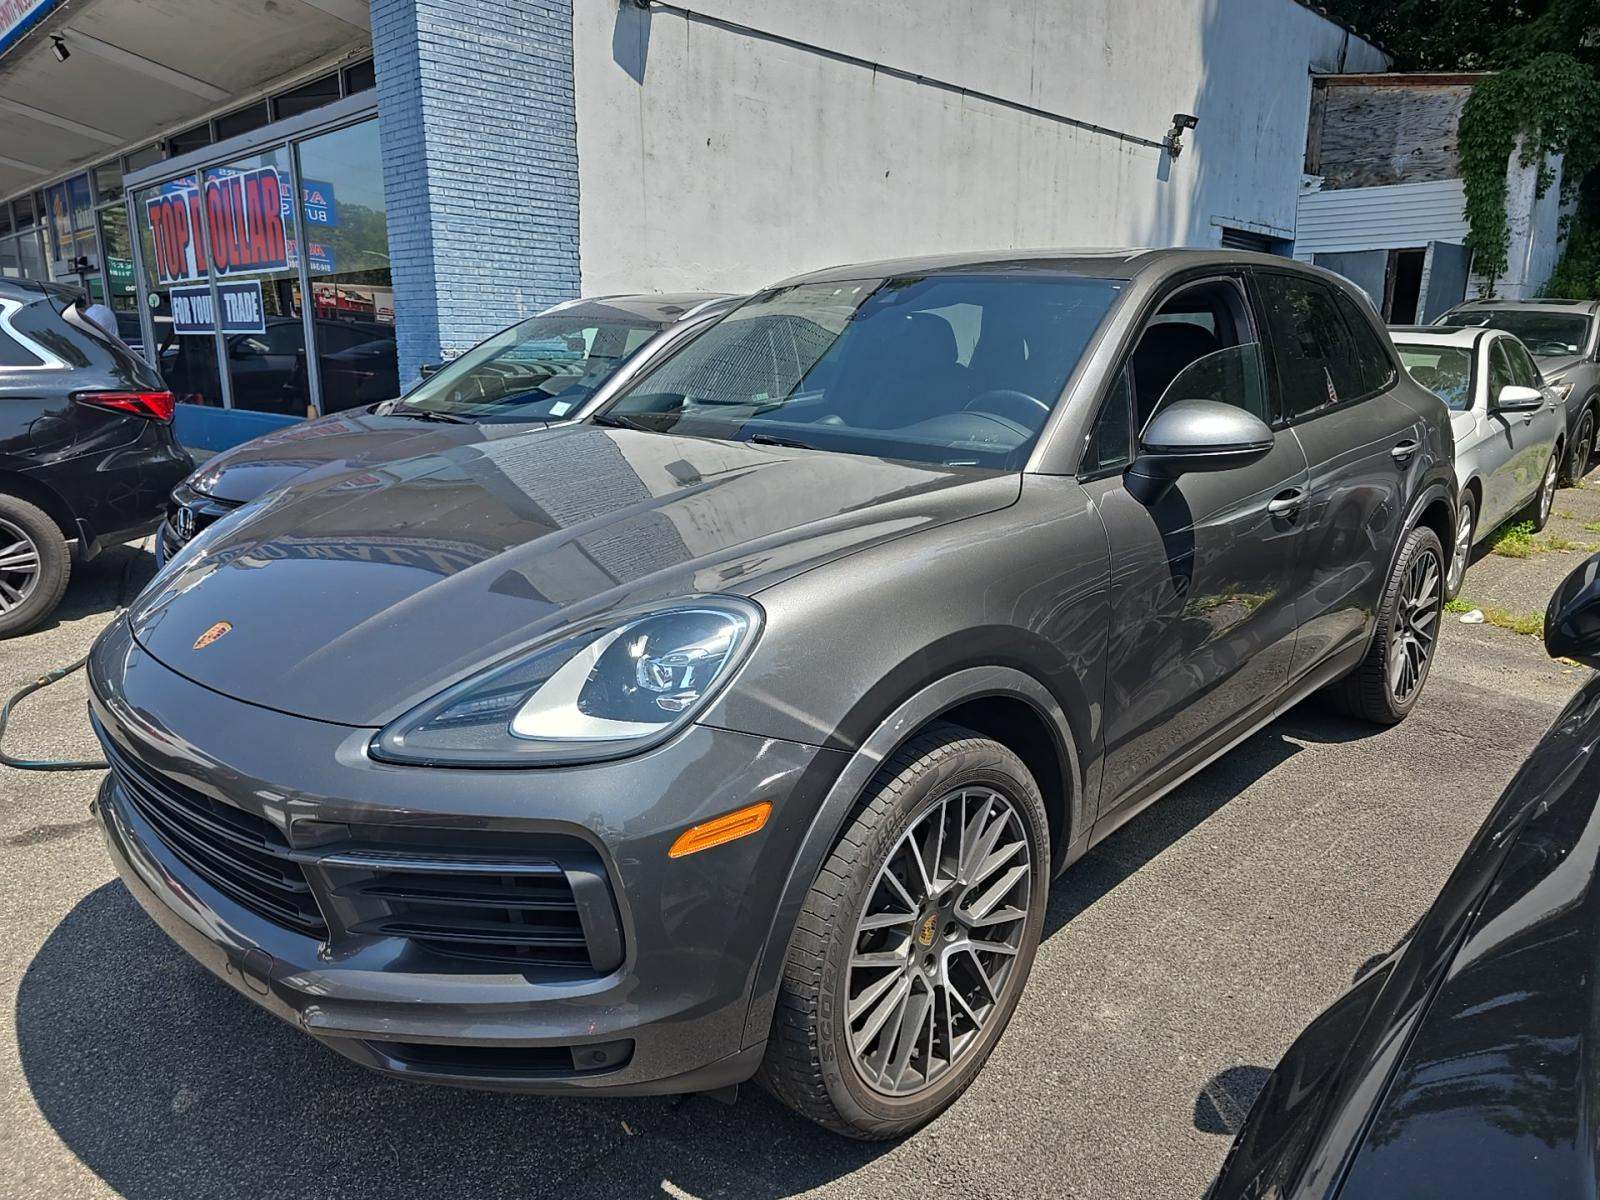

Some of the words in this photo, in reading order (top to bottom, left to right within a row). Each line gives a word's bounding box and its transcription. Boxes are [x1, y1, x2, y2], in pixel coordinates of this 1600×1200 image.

[149, 199, 190, 279] TOP
[190, 173, 285, 273] DOLLAR
[172, 296, 192, 324] FOR
[223, 291, 260, 323] TRADE
